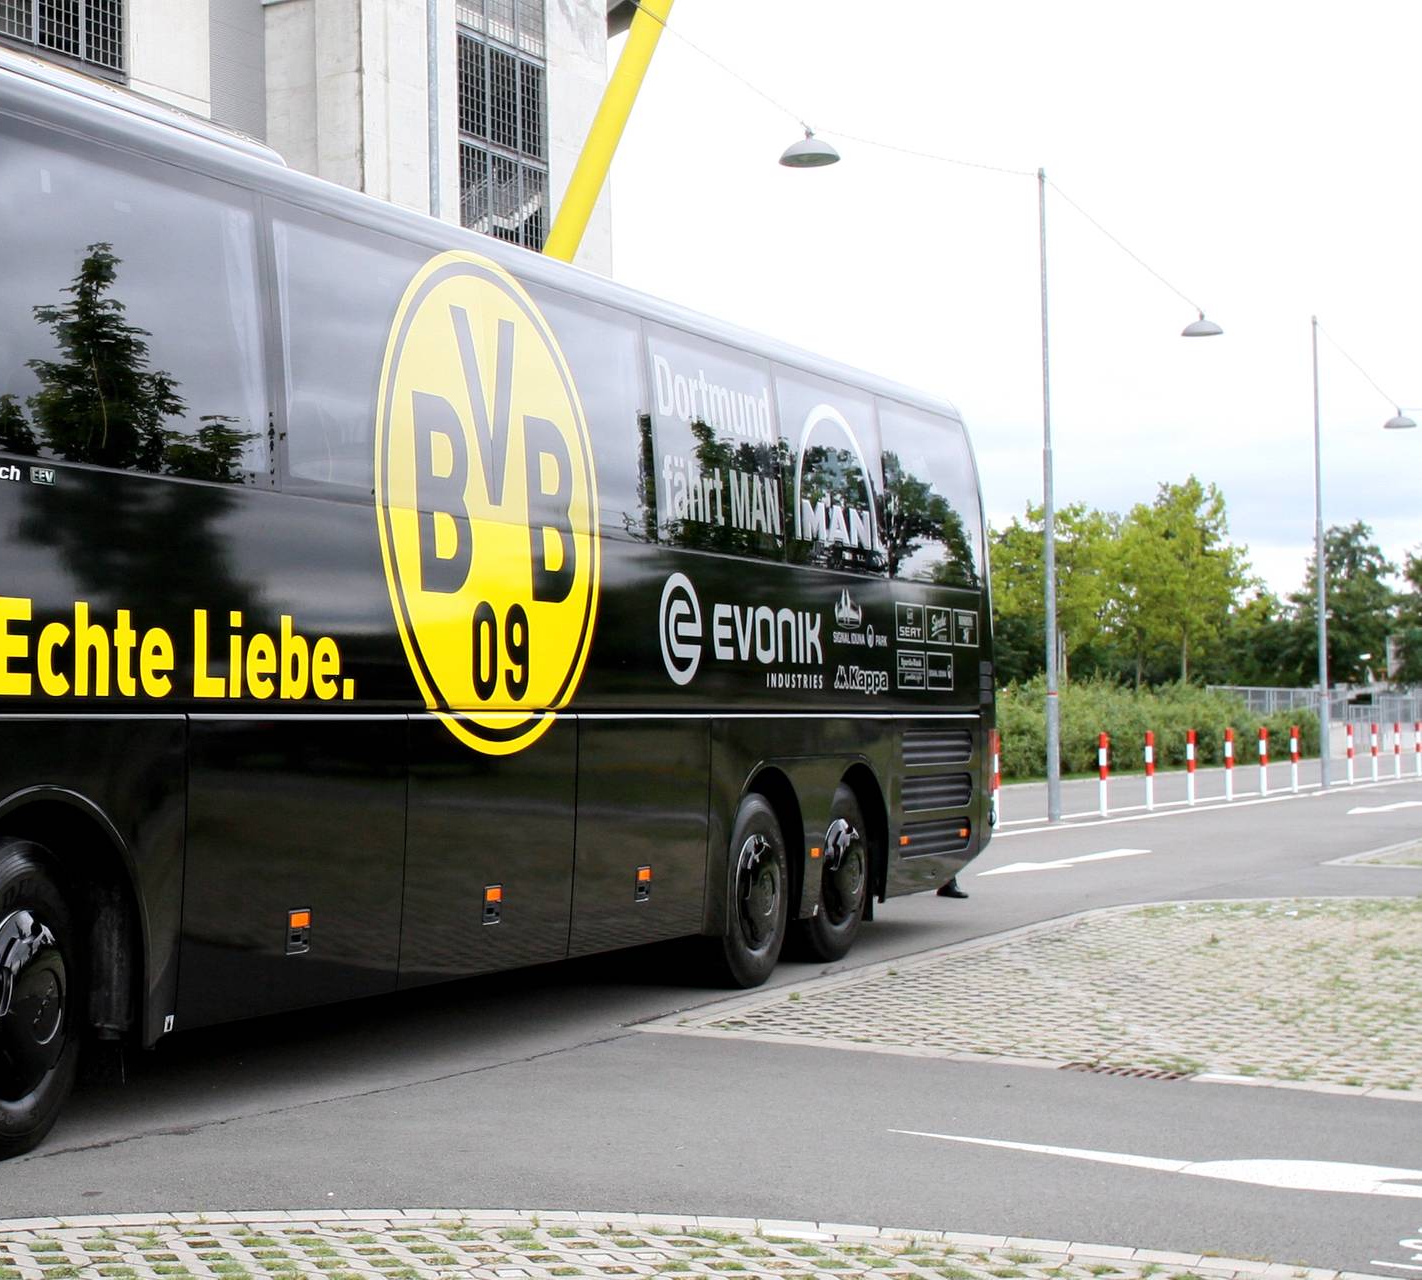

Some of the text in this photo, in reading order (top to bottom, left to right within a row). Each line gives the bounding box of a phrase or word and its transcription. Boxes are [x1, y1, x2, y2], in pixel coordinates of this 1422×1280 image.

[653, 354, 774, 441] Dortmund
[32, 468, 54, 483] EEV
[412, 304, 575, 604] BVB
[662, 454, 783, 536] fährt MAN
[802, 499, 872, 549] MAN
[193, 609, 355, 700] Liebe.
[471, 600, 530, 702] 09
[712, 603, 824, 665] EVONIK
[875, 635, 888, 647] PARK
[898, 626, 922, 638] SEAT
[766, 673, 824, 690] INDUSTRIES
[849, 666, 889, 695] Kappa
